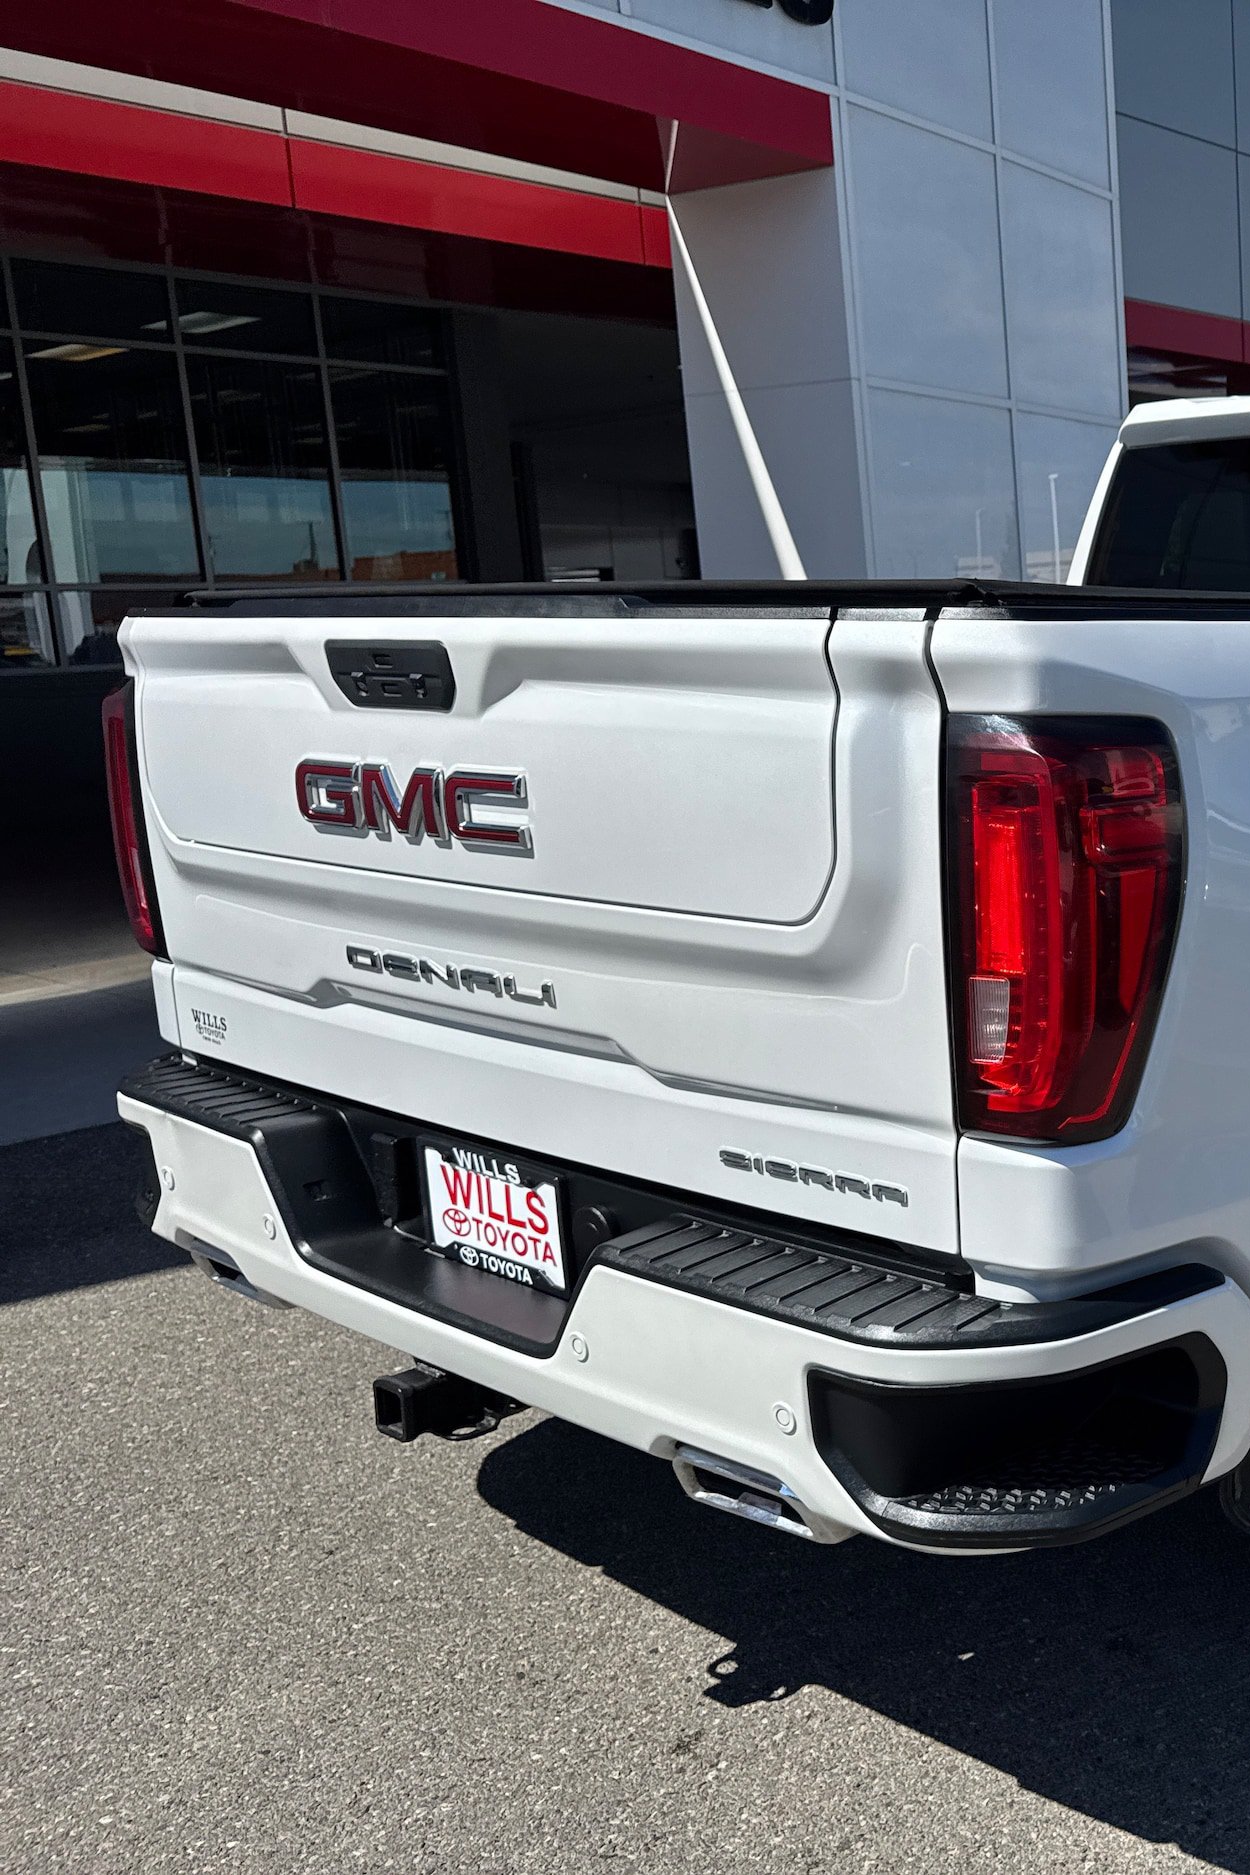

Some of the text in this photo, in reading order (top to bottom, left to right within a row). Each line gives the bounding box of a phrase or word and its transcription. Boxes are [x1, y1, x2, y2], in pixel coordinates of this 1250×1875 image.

[295, 756, 532, 851] GMC
[346, 945, 557, 1009] DENALI
[191, 1008, 227, 1032] WILLS
[452, 1147, 521, 1185] WILLS
[718, 1147, 909, 1207] SIERRA
[440, 1164, 549, 1235] WILLS
[472, 1217, 558, 1267] TOYOTA
[479, 1252, 534, 1286] TOYOTA
